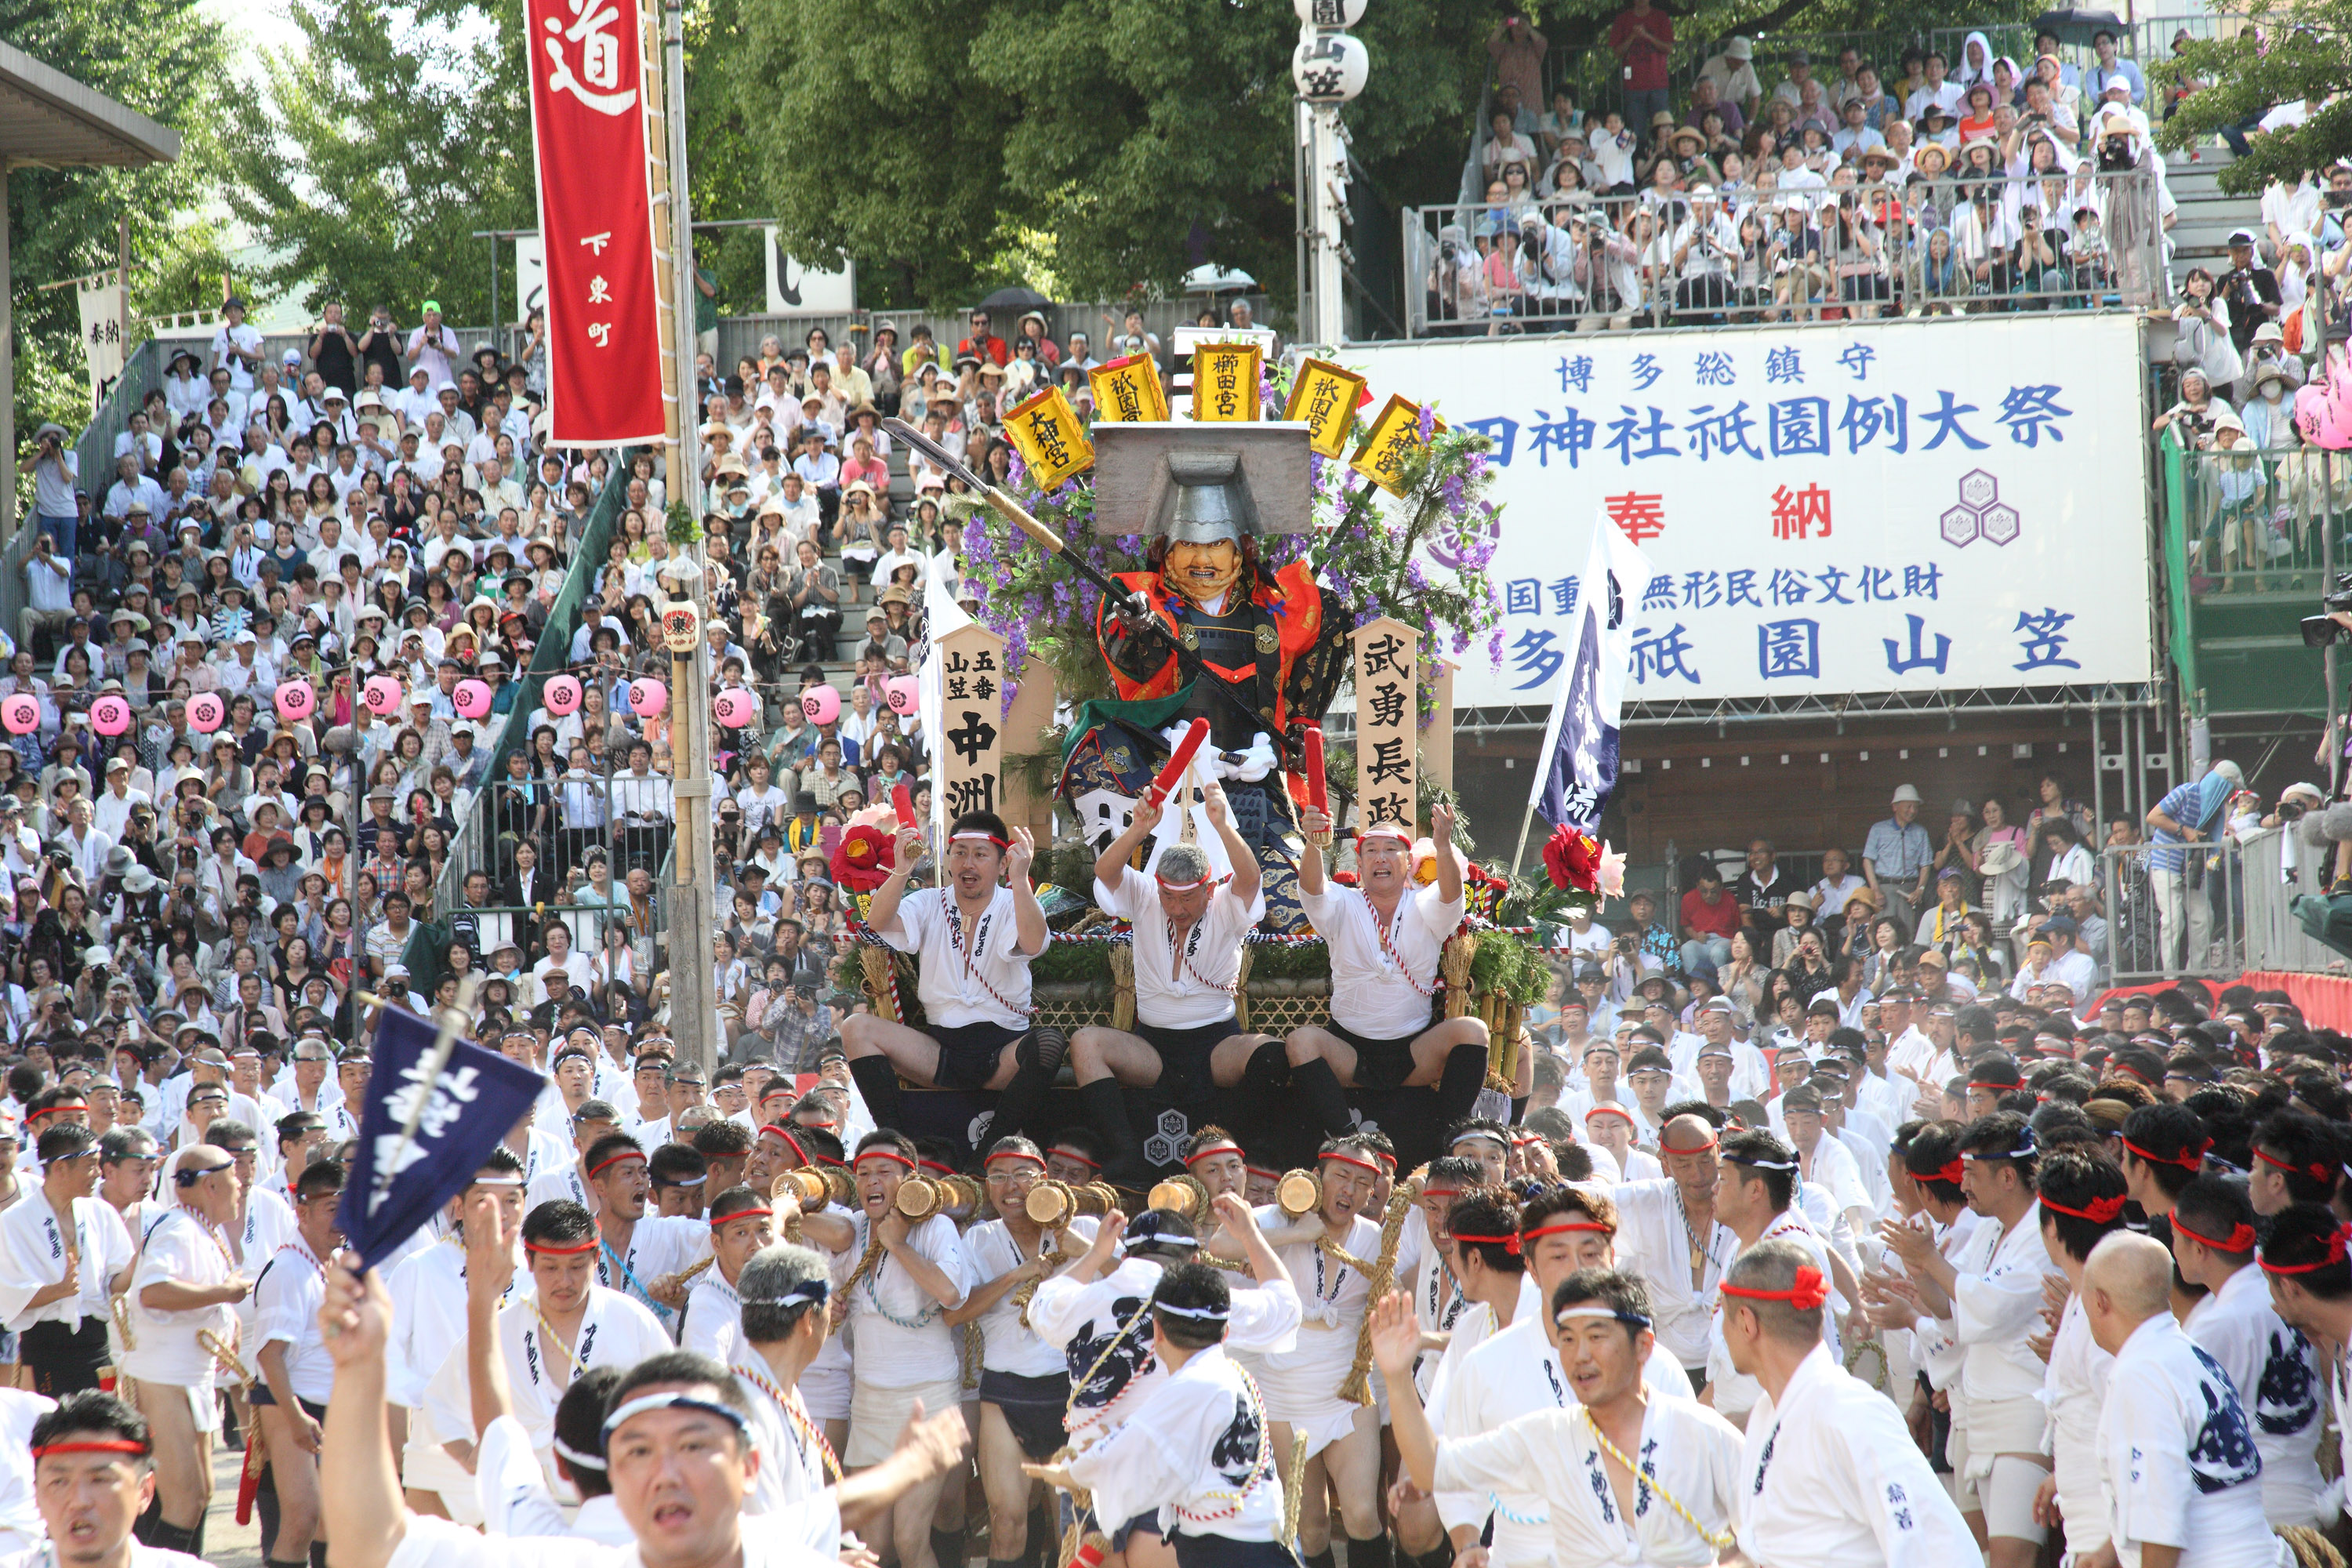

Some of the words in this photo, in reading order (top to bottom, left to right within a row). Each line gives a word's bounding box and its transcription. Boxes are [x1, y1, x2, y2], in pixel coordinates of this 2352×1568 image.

[544, 0, 637, 116] 道
[1301, 36, 1346, 97] 山笠
[580, 231, 612, 347] 下東町
[1213, 354, 1240, 417] 櫛田宮
[1555, 341, 1877, 394] 博多総鎮守
[1029, 410, 1070, 469] 大神宮
[1451, 384, 2074, 470] 田神社祇園例大祭
[1604, 482, 1833, 546] 奉納
[1506, 561, 1944, 616] 国重無形民俗文化財
[945, 652, 971, 701] 山笠
[971, 650, 997, 701] 五番
[1436, 608, 2082, 690] 多祇園山笠
[1363, 633, 1413, 828] 武勇長政
[945, 710, 997, 819] 中洲
